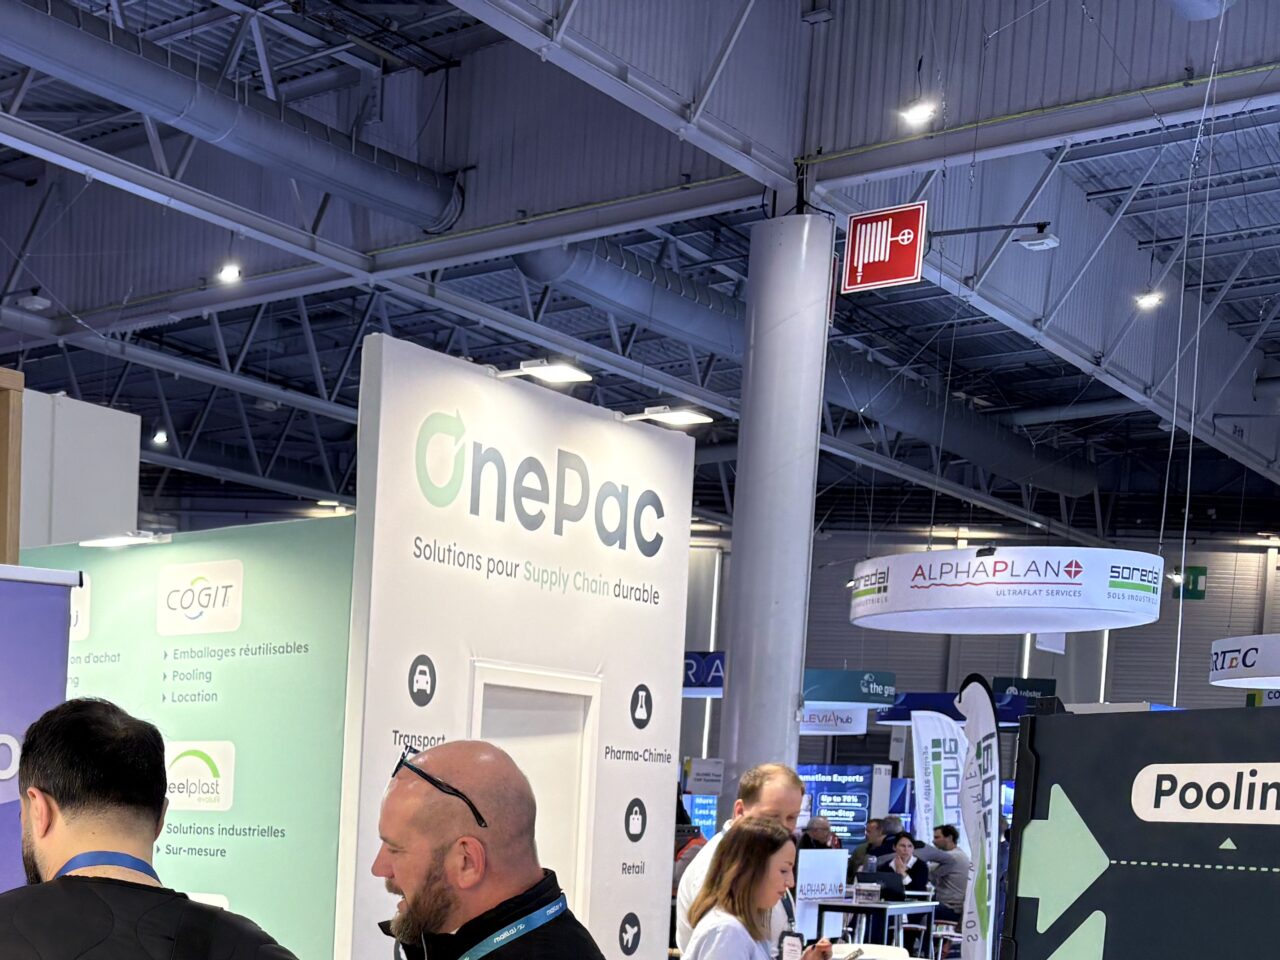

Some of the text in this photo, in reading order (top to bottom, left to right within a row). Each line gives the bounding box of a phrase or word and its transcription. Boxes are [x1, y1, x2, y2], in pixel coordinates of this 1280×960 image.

[415, 408, 665, 558] OnePac
[413, 536, 660, 606] Solutions pour Supply Chain durable
[911, 559, 1061, 582] ALPHAPLAN
[166, 584, 234, 611] COGIT
[996, 588, 1082, 598] ULTRAFLAT SERVICES
[173, 641, 310, 661] Emballages réutilisables
[172, 668, 212, 683] Pooling
[869, 682, 883, 695] the
[171, 690, 218, 703] Location
[604, 745, 672, 765] Pharma-Chimie
[832, 773, 864, 784] Experts
[166, 823, 286, 838] Solutions industrielles
[165, 844, 227, 858] Sur-mesure
[621, 862, 645, 875] Retail
